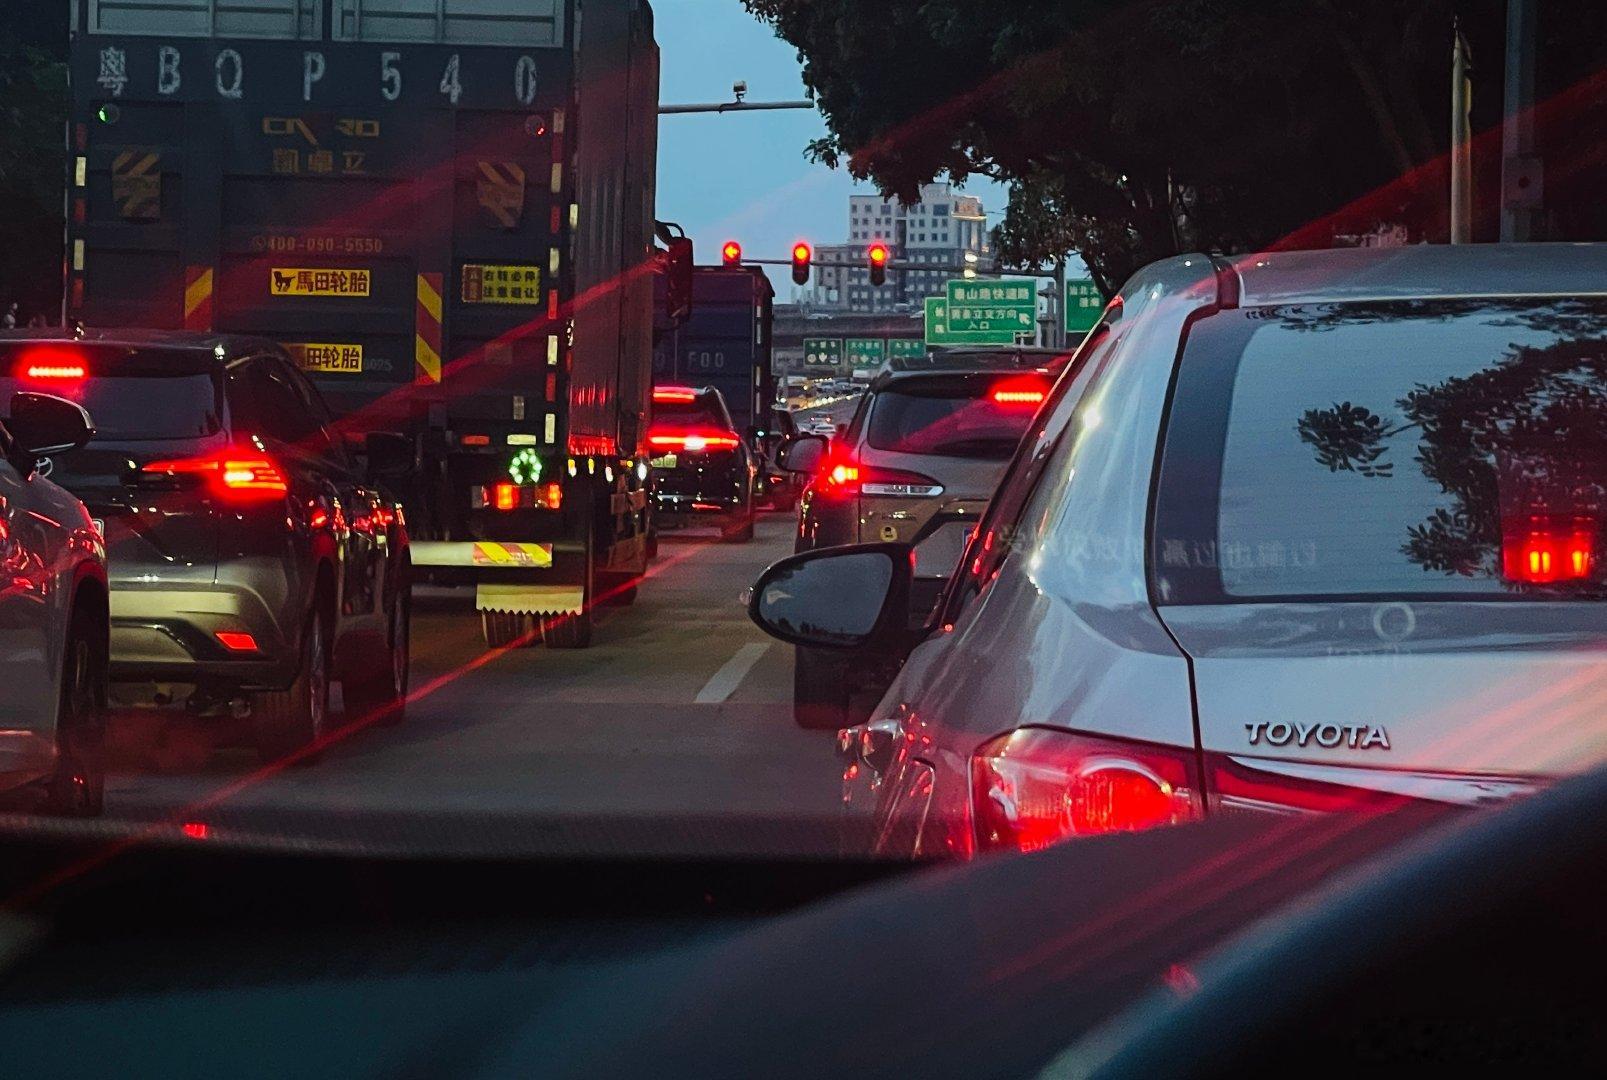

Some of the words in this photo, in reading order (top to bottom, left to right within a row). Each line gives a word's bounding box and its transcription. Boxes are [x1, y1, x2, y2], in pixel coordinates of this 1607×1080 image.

[296, 270, 368, 293] 馬田轮胎
[306, 345, 360, 369] 田轮胎
[1245, 720, 1391, 750] TOYOTA
